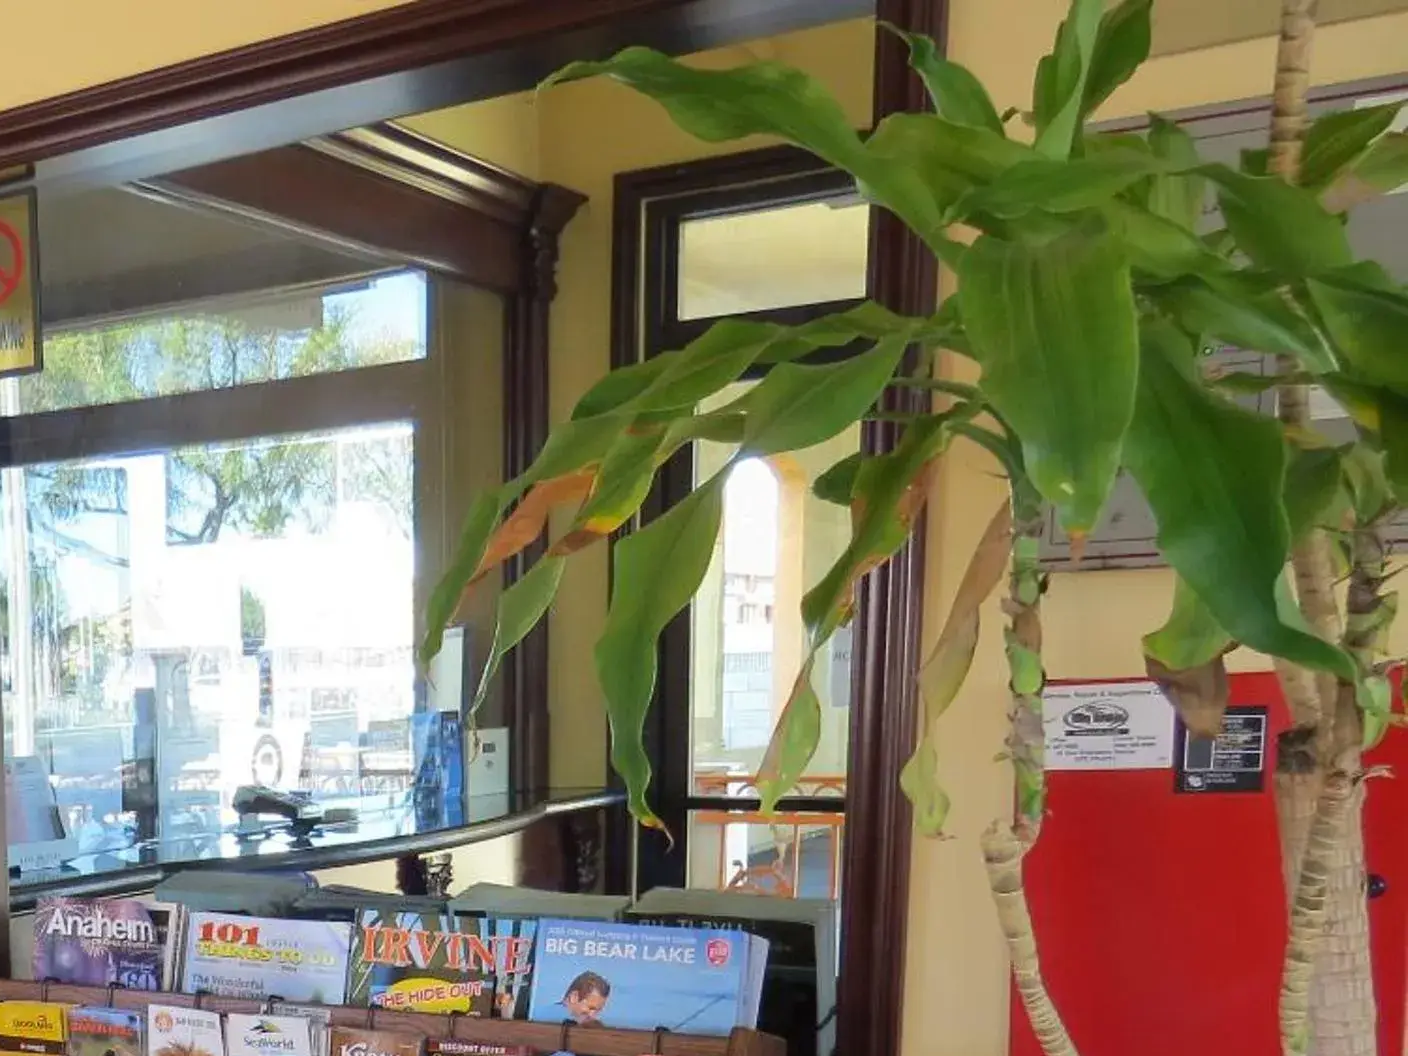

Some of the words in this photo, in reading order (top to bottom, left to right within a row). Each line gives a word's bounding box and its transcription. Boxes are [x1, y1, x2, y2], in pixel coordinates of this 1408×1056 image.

[47, 906, 154, 942] Anaheim
[197, 921, 261, 946] 101
[362, 925, 533, 974] IRVINE
[545, 938, 577, 955] BIG
[583, 940, 637, 960] BEAR
[642, 946, 696, 964] LAKE
[409, 988, 446, 1006] HIDE
[450, 982, 485, 999] OUT
[243, 1036, 295, 1050] SeaWorld
